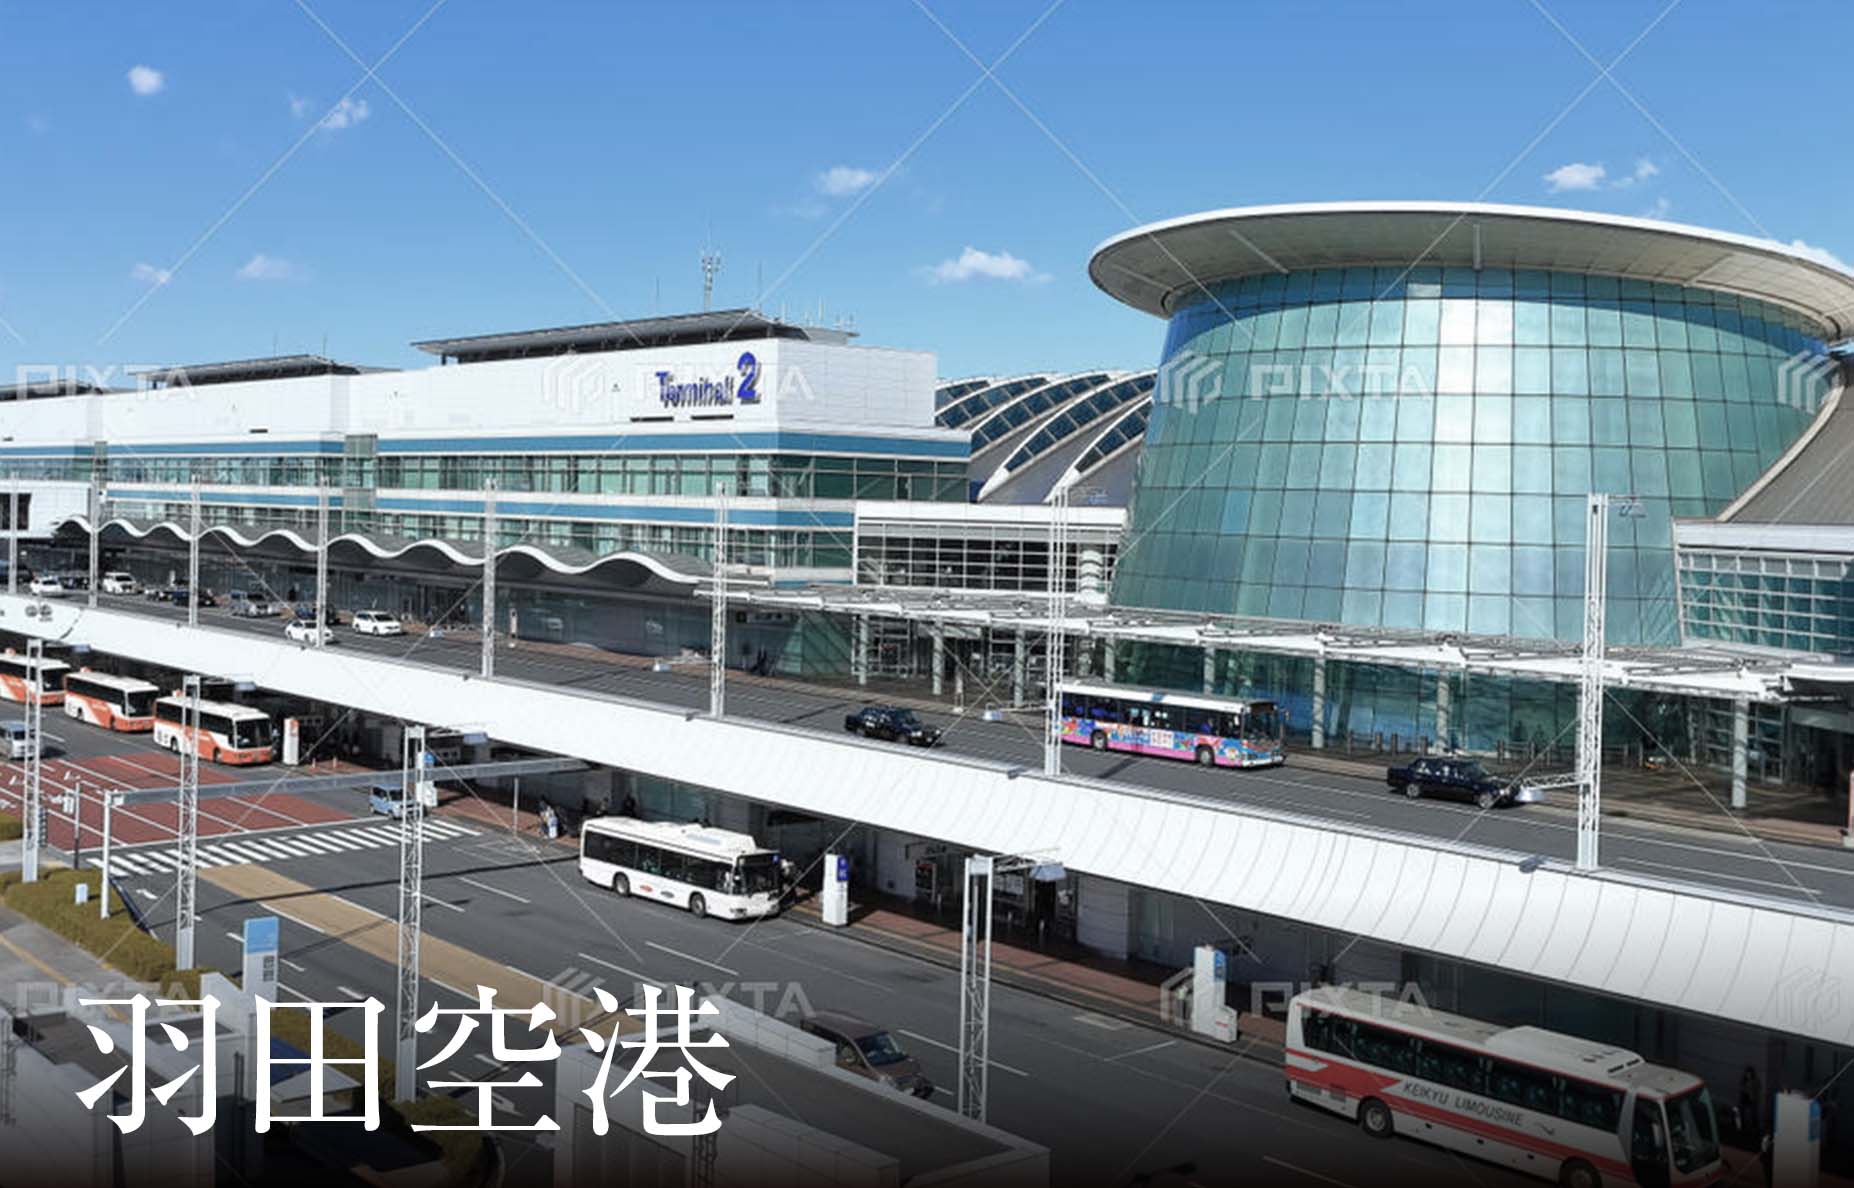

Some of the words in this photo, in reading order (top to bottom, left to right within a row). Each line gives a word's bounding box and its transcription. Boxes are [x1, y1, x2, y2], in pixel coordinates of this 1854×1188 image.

[656, 371, 733, 406] Terminal
[736, 352, 760, 402] 2
[1402, 1081, 1449, 1105] KEIKYU
[1455, 1097, 1525, 1127] LIMOUSINE
